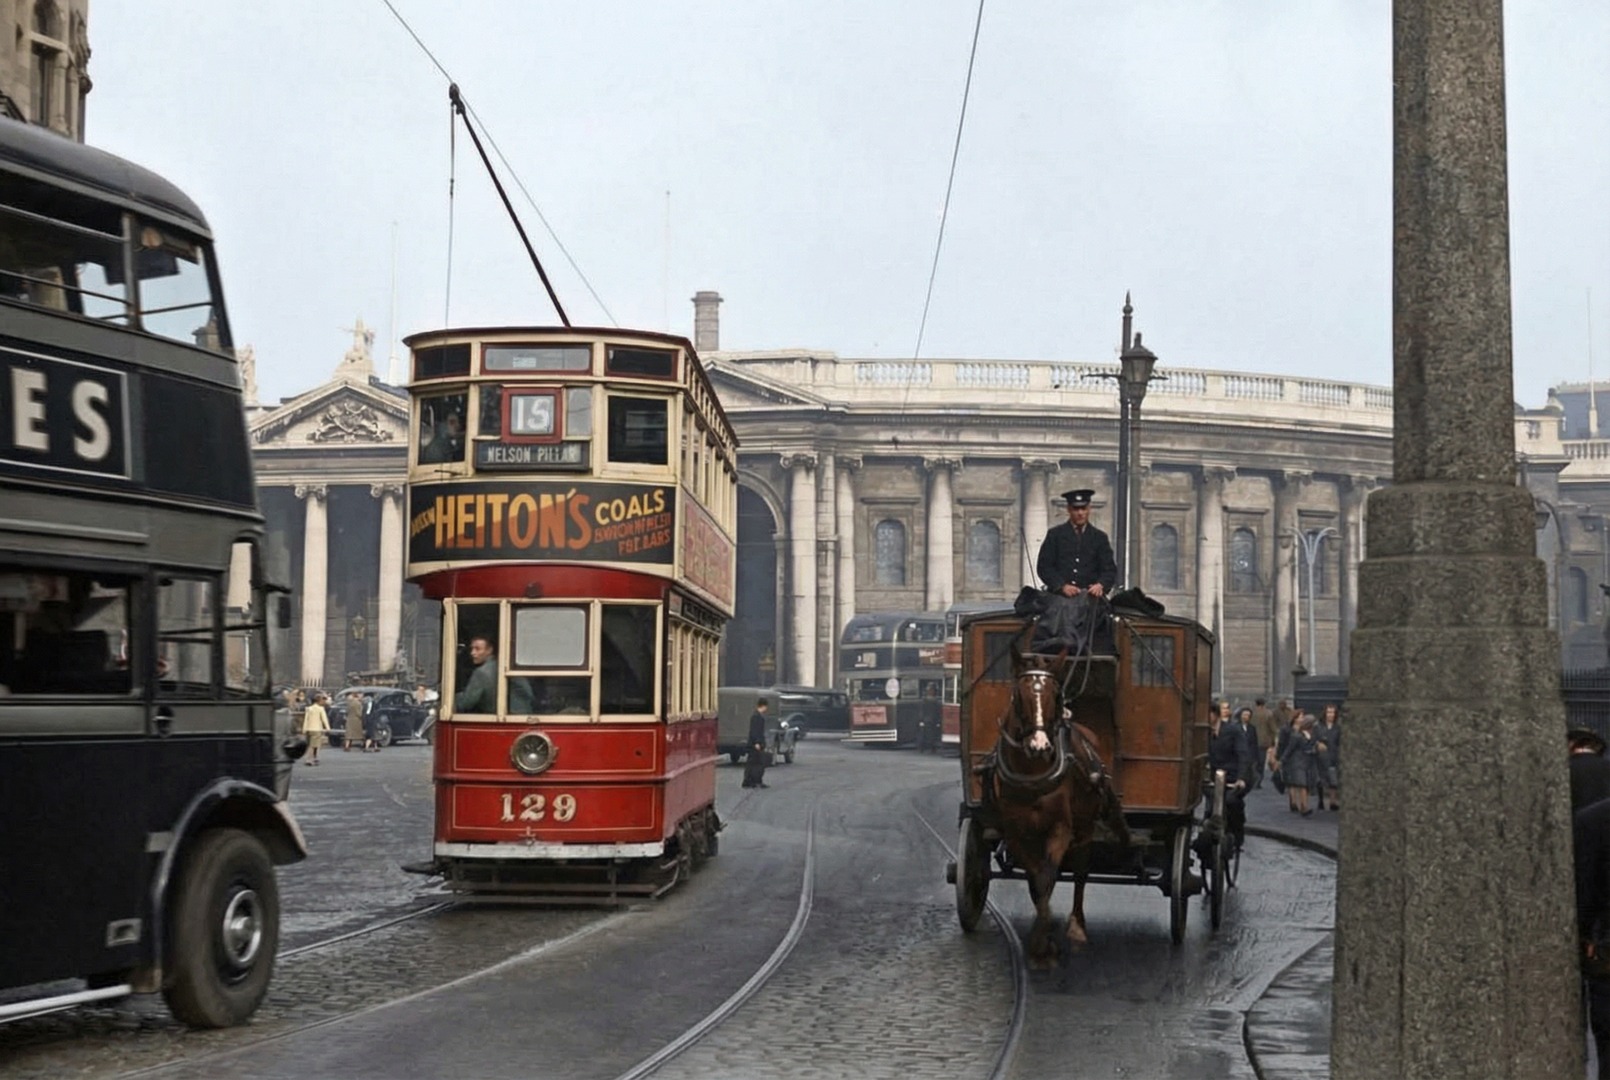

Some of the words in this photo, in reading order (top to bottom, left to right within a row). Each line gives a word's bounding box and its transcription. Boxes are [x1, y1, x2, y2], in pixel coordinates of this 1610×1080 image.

[516, 397, 551, 430] 15
[488, 446, 530, 463] NELSON
[435, 488, 591, 550] HEITON'S
[595, 489, 665, 525] COALS
[501, 794, 577, 822] 129
